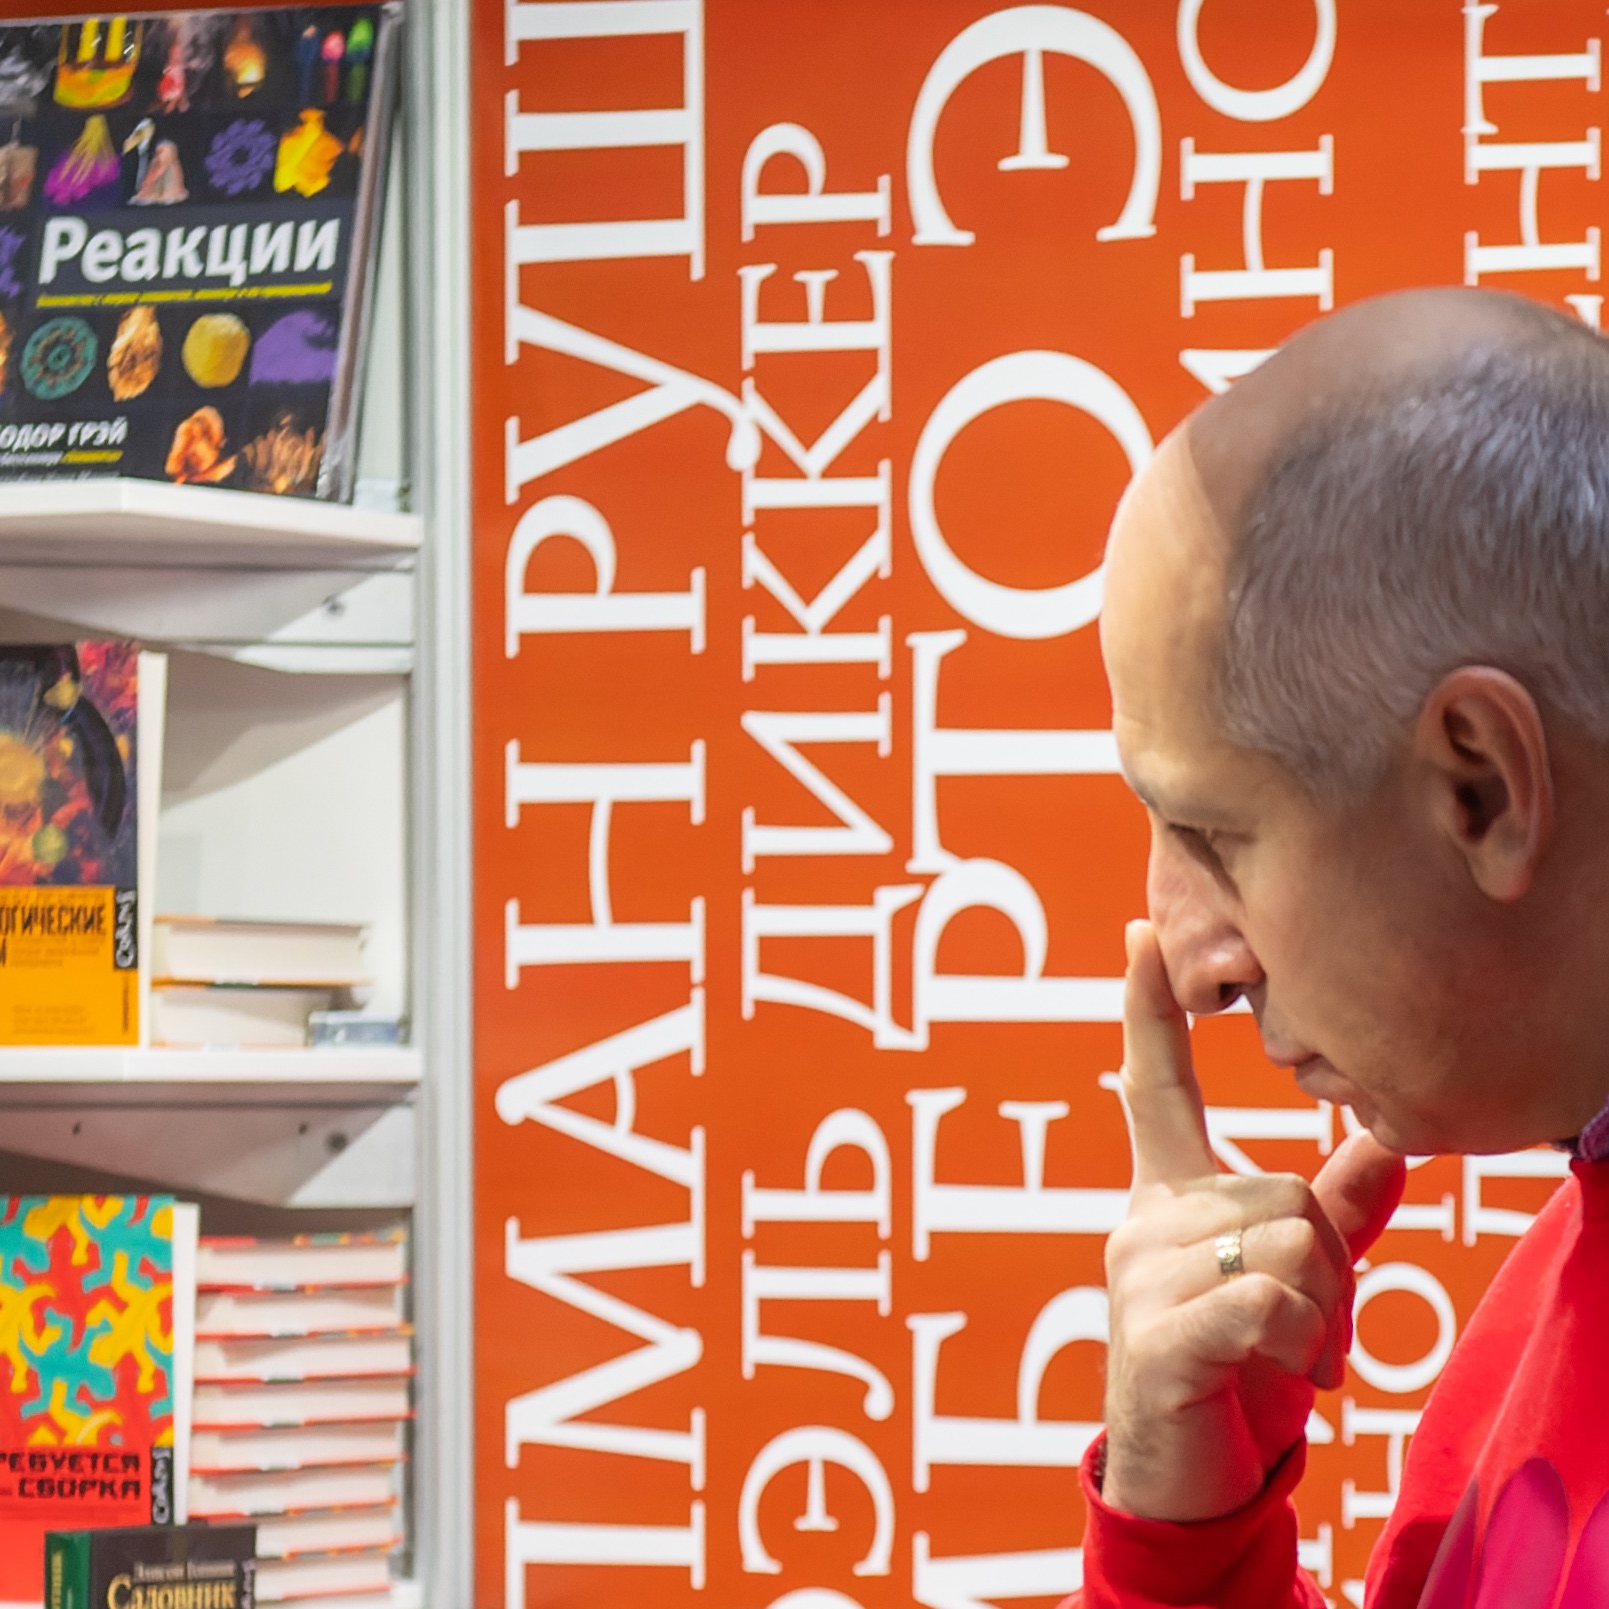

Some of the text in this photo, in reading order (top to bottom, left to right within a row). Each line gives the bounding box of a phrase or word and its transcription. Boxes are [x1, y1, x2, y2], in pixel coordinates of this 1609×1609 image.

[906, 5, 1162, 246] Э
[1178, 0, 1336, 395] НО
[37, 215, 341, 287] Реакции
[67, 415, 129, 448] ГРЭЙ
[738, 122, 929, 1051] ДИККЕР
[17, 1477, 142, 1500] СБОРКА
